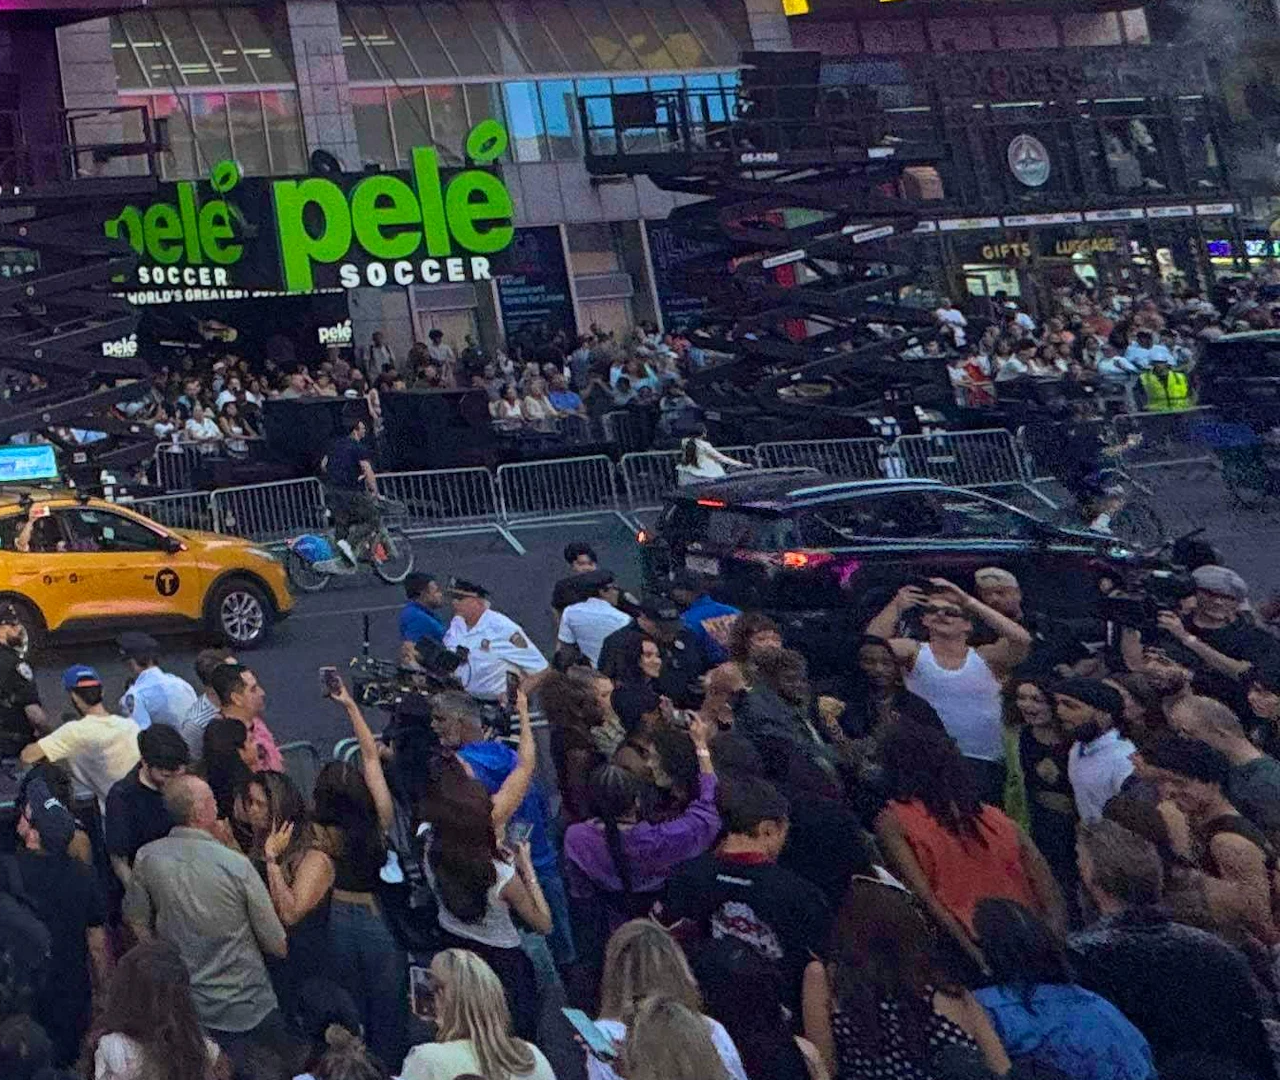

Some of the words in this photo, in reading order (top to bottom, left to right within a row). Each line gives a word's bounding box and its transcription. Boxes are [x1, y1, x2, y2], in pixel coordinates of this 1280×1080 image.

[272, 119, 515, 293] pelé
[982, 242, 1032, 260] GIFTS
[138, 266, 228, 287] SOCCER
[340, 256, 491, 289] SOCCER
[127, 289, 183, 305] WORLD'S
[102, 333, 138, 356] pelé
[318, 319, 352, 344] pelé
